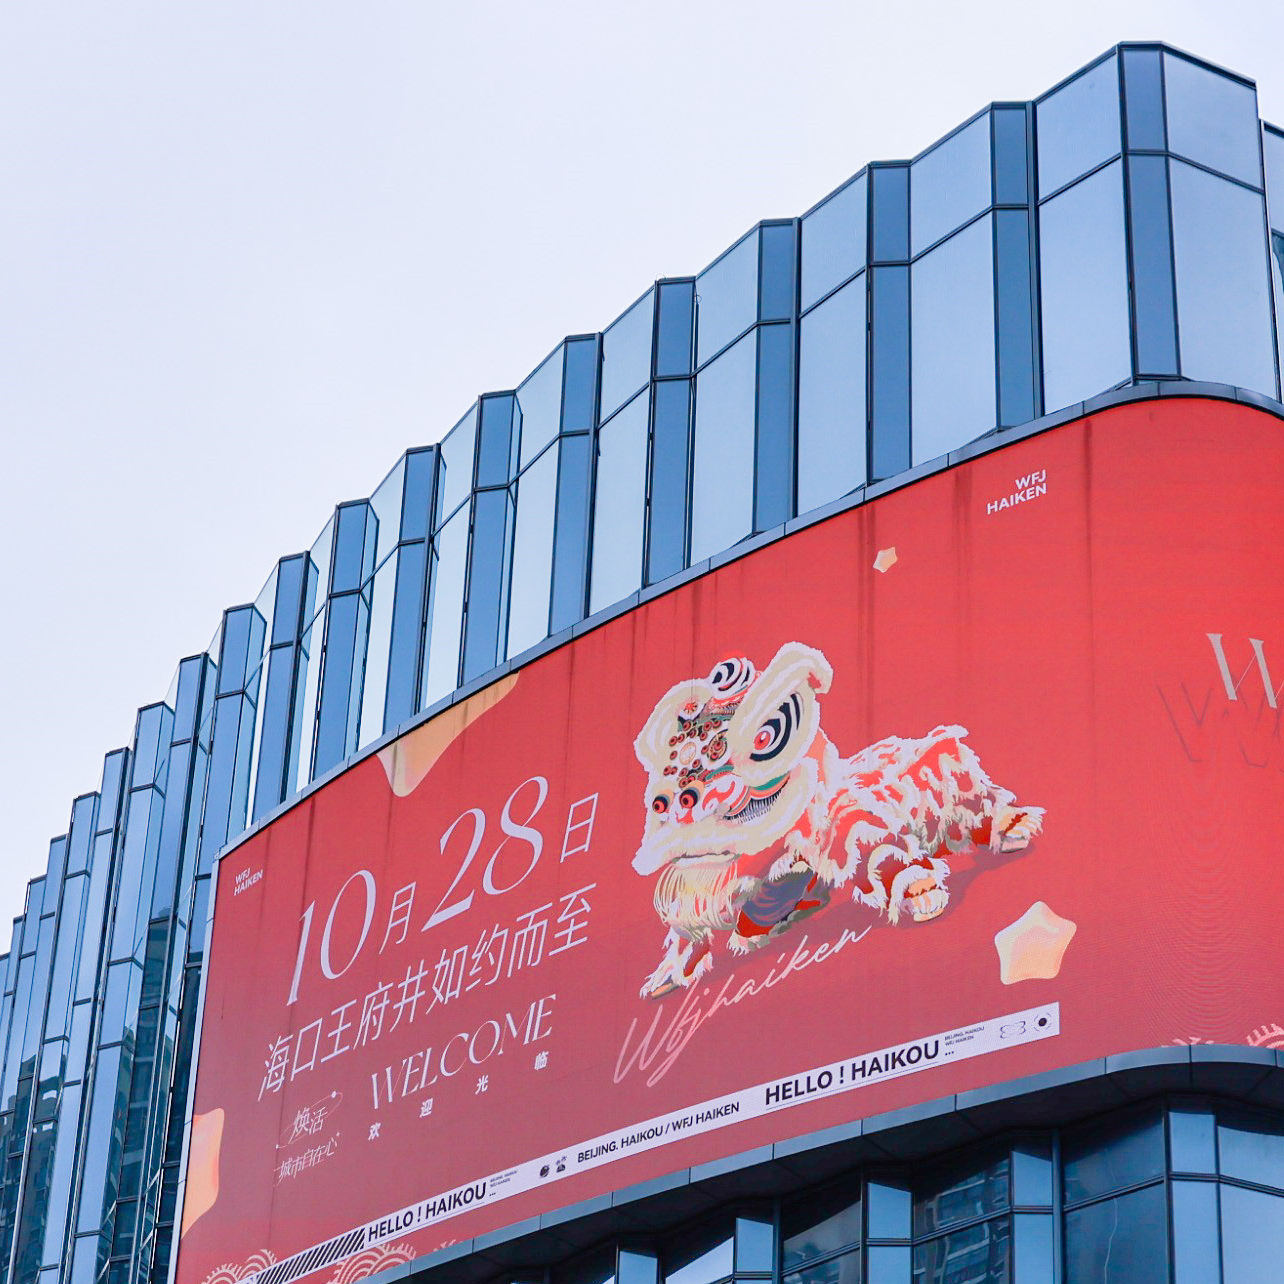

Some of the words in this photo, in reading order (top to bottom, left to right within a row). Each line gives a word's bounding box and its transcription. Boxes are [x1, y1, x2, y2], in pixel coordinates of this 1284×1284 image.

[987, 482, 1047, 515] HAIKEN
[1015, 469, 1046, 490] WFJ
[258, 883, 597, 1102] 海口王府井如约而至
[372, 994, 556, 1109] WELCOME
[765, 1071, 833, 1106] HELLO
[852, 1039, 939, 1082] HAIKOU
[577, 1141, 619, 1164] BEIJING.
[621, 1125, 664, 1153] HAIKOU
[672, 1116, 694, 1134] WFJ
[696, 1101, 740, 1127] HAIKEN
[368, 1210, 414, 1242] HELLO
[425, 1182, 487, 1221] HAIKOU
